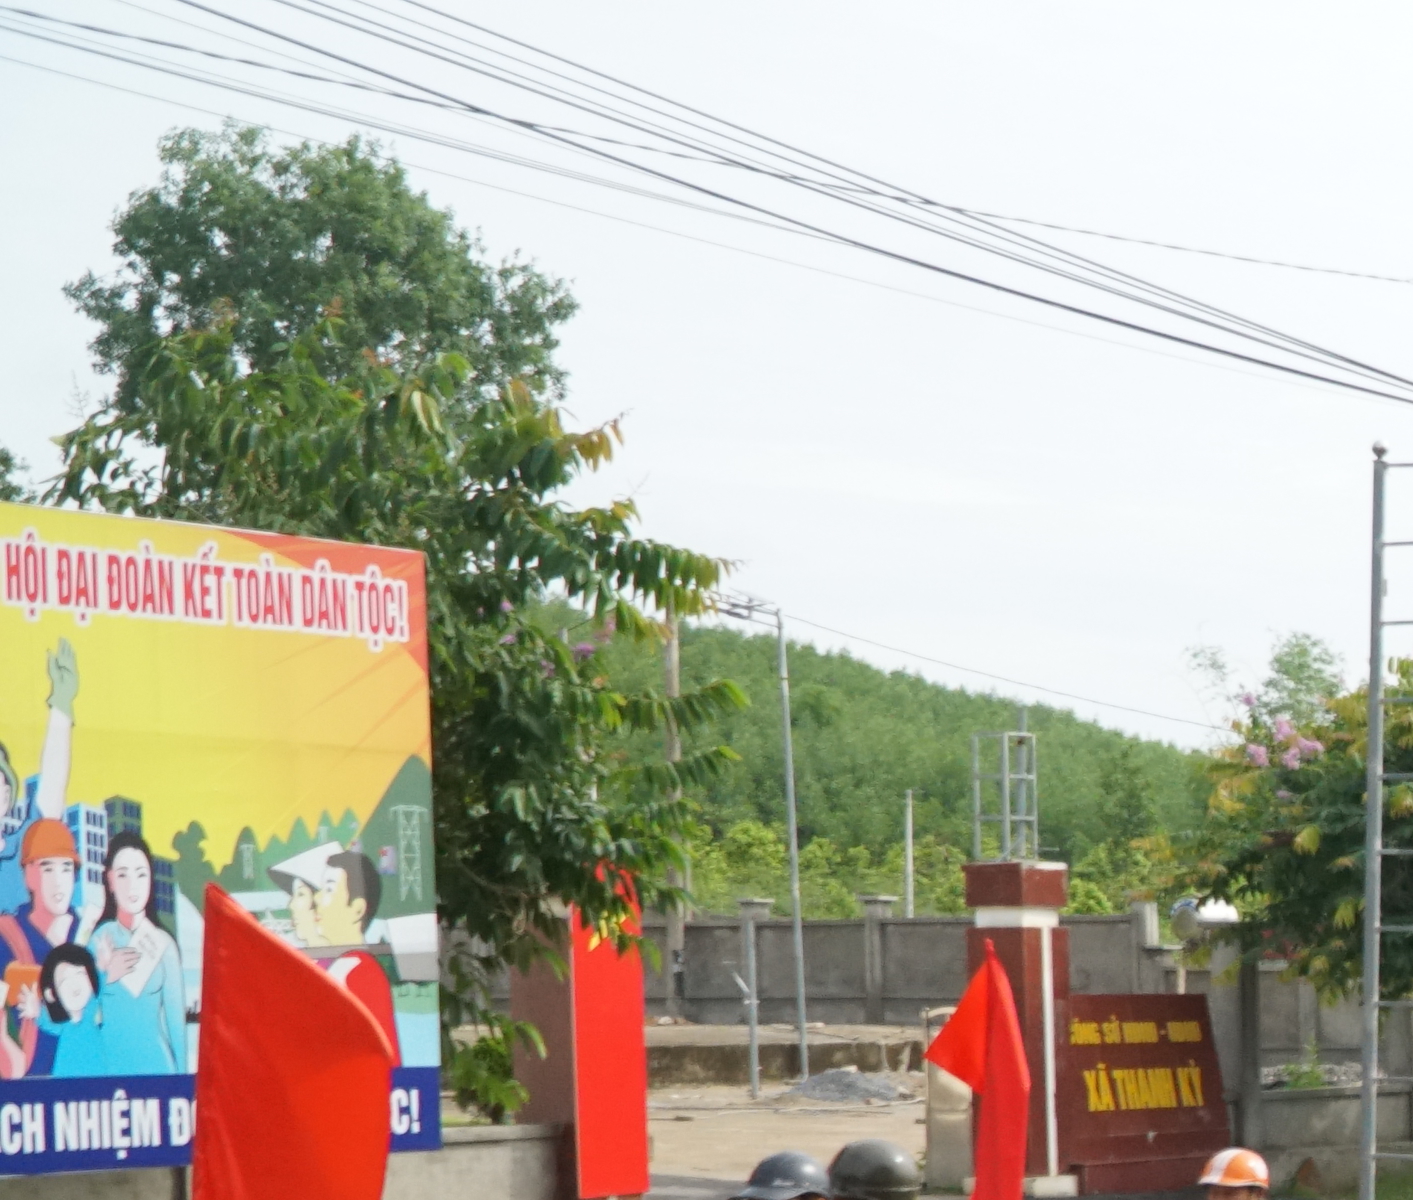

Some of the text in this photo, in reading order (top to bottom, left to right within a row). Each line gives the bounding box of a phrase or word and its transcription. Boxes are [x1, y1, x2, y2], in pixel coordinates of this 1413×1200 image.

[4, 532, 407, 647] HỘI ĐẠI ĐOÀN KẾT TOÀN DÂN TỘC!
[1083, 1063, 1116, 1112] XÃ
[1112, 1067, 1178, 1110] THANH
[0, 1102, 46, 1155] CH
[53, 1088, 161, 1160] NHIỆM
[168, 1098, 197, 1148] Đ
